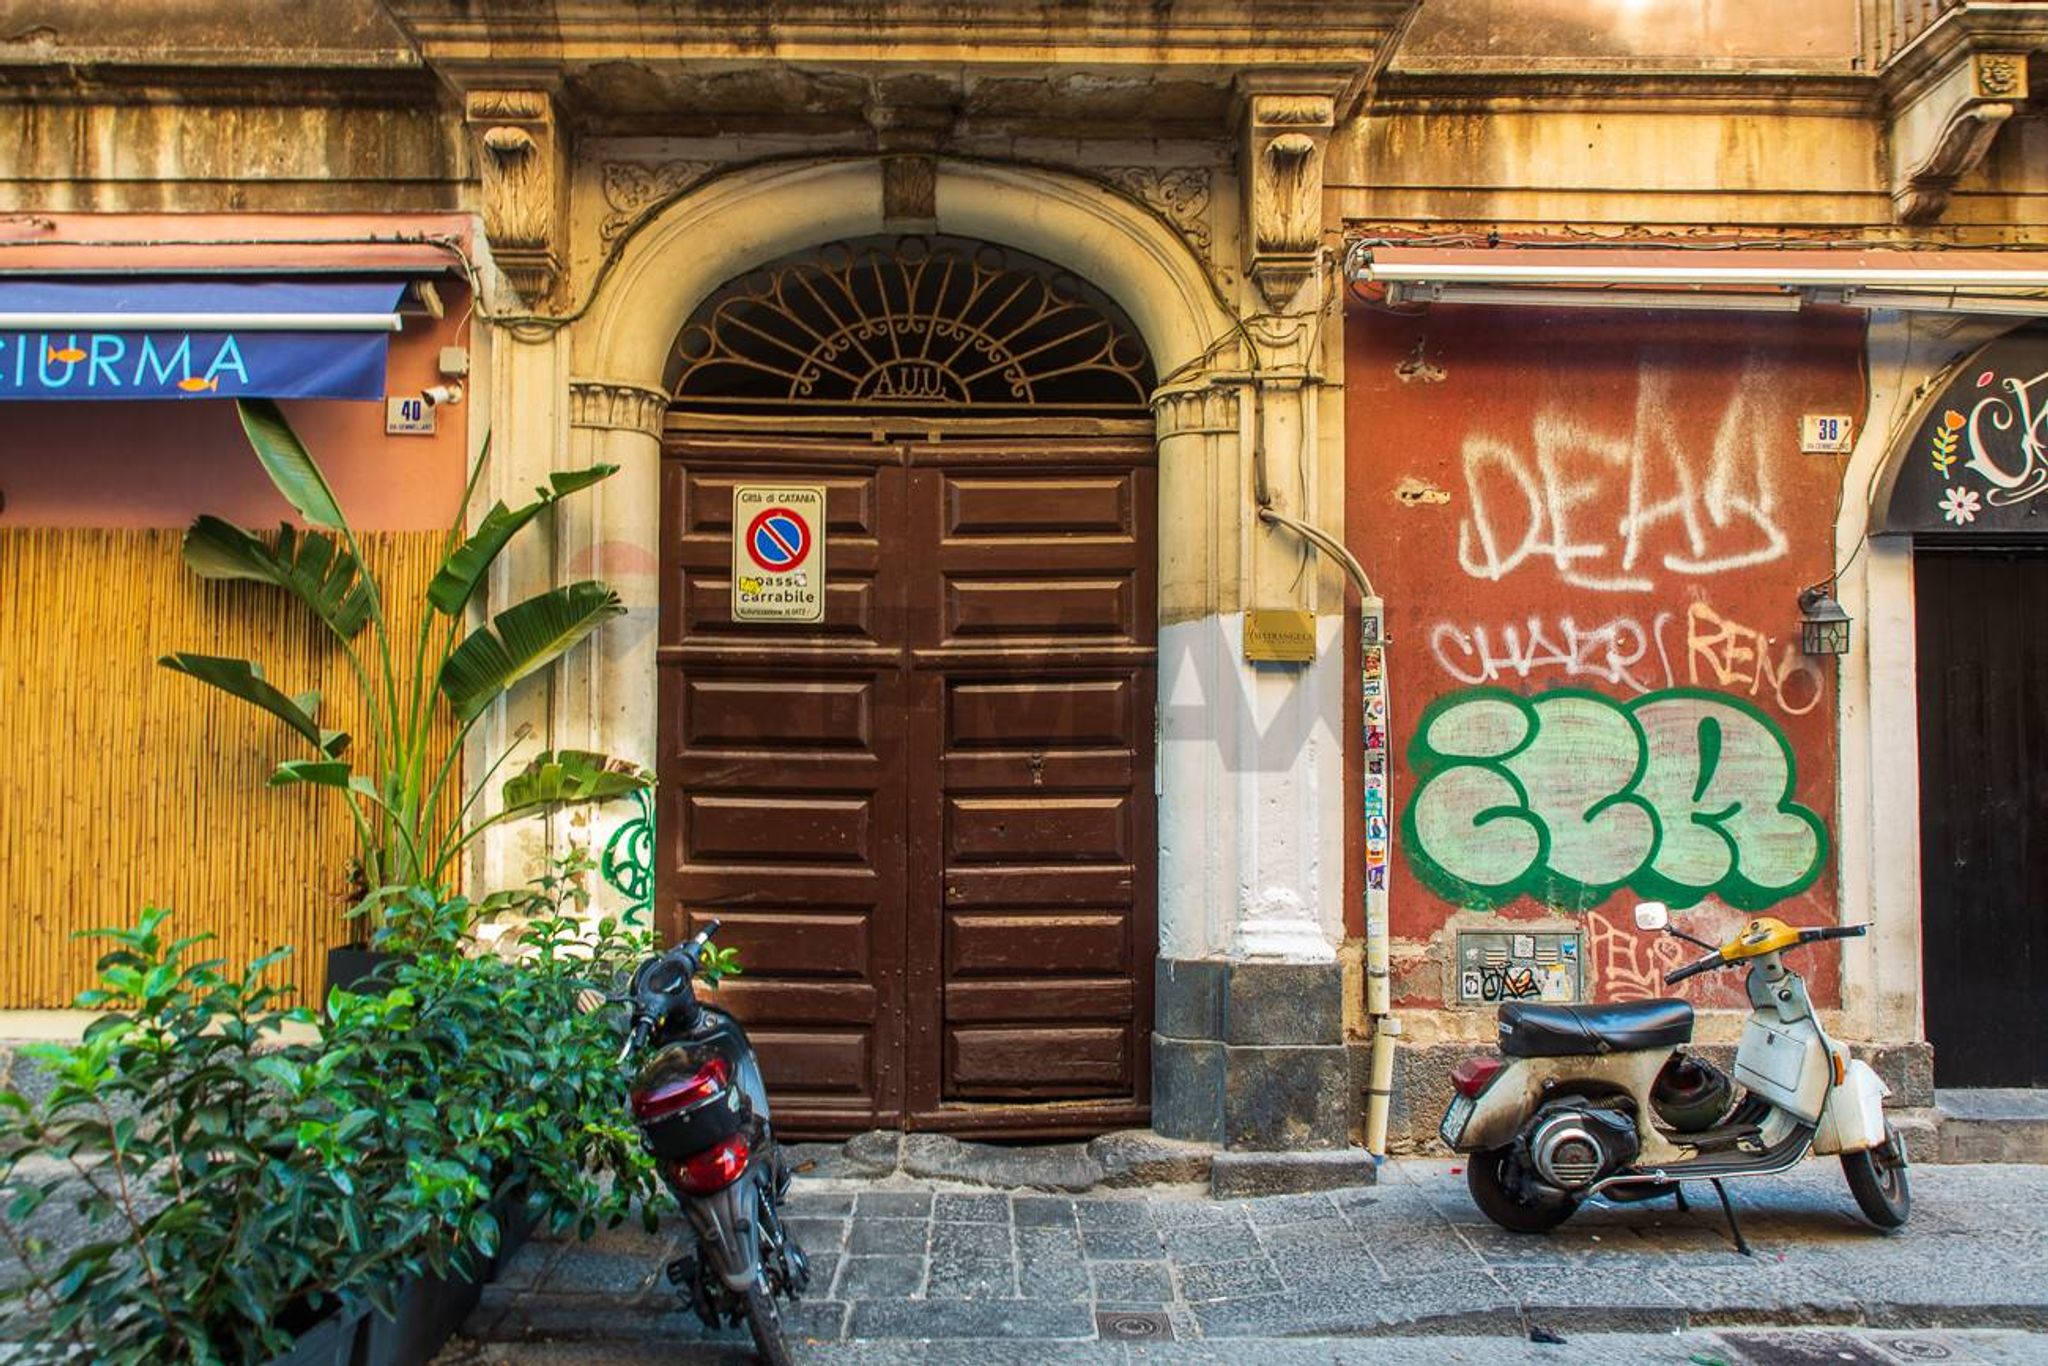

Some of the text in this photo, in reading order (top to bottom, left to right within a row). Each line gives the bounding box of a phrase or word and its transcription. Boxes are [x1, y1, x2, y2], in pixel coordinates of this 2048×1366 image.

[0, 334, 248, 387] IURMA
[401, 400, 421, 421] 40
[1819, 419, 1837, 440] 38
[778, 494, 816, 503] CATANIA
[741, 590, 814, 603] carrabile
